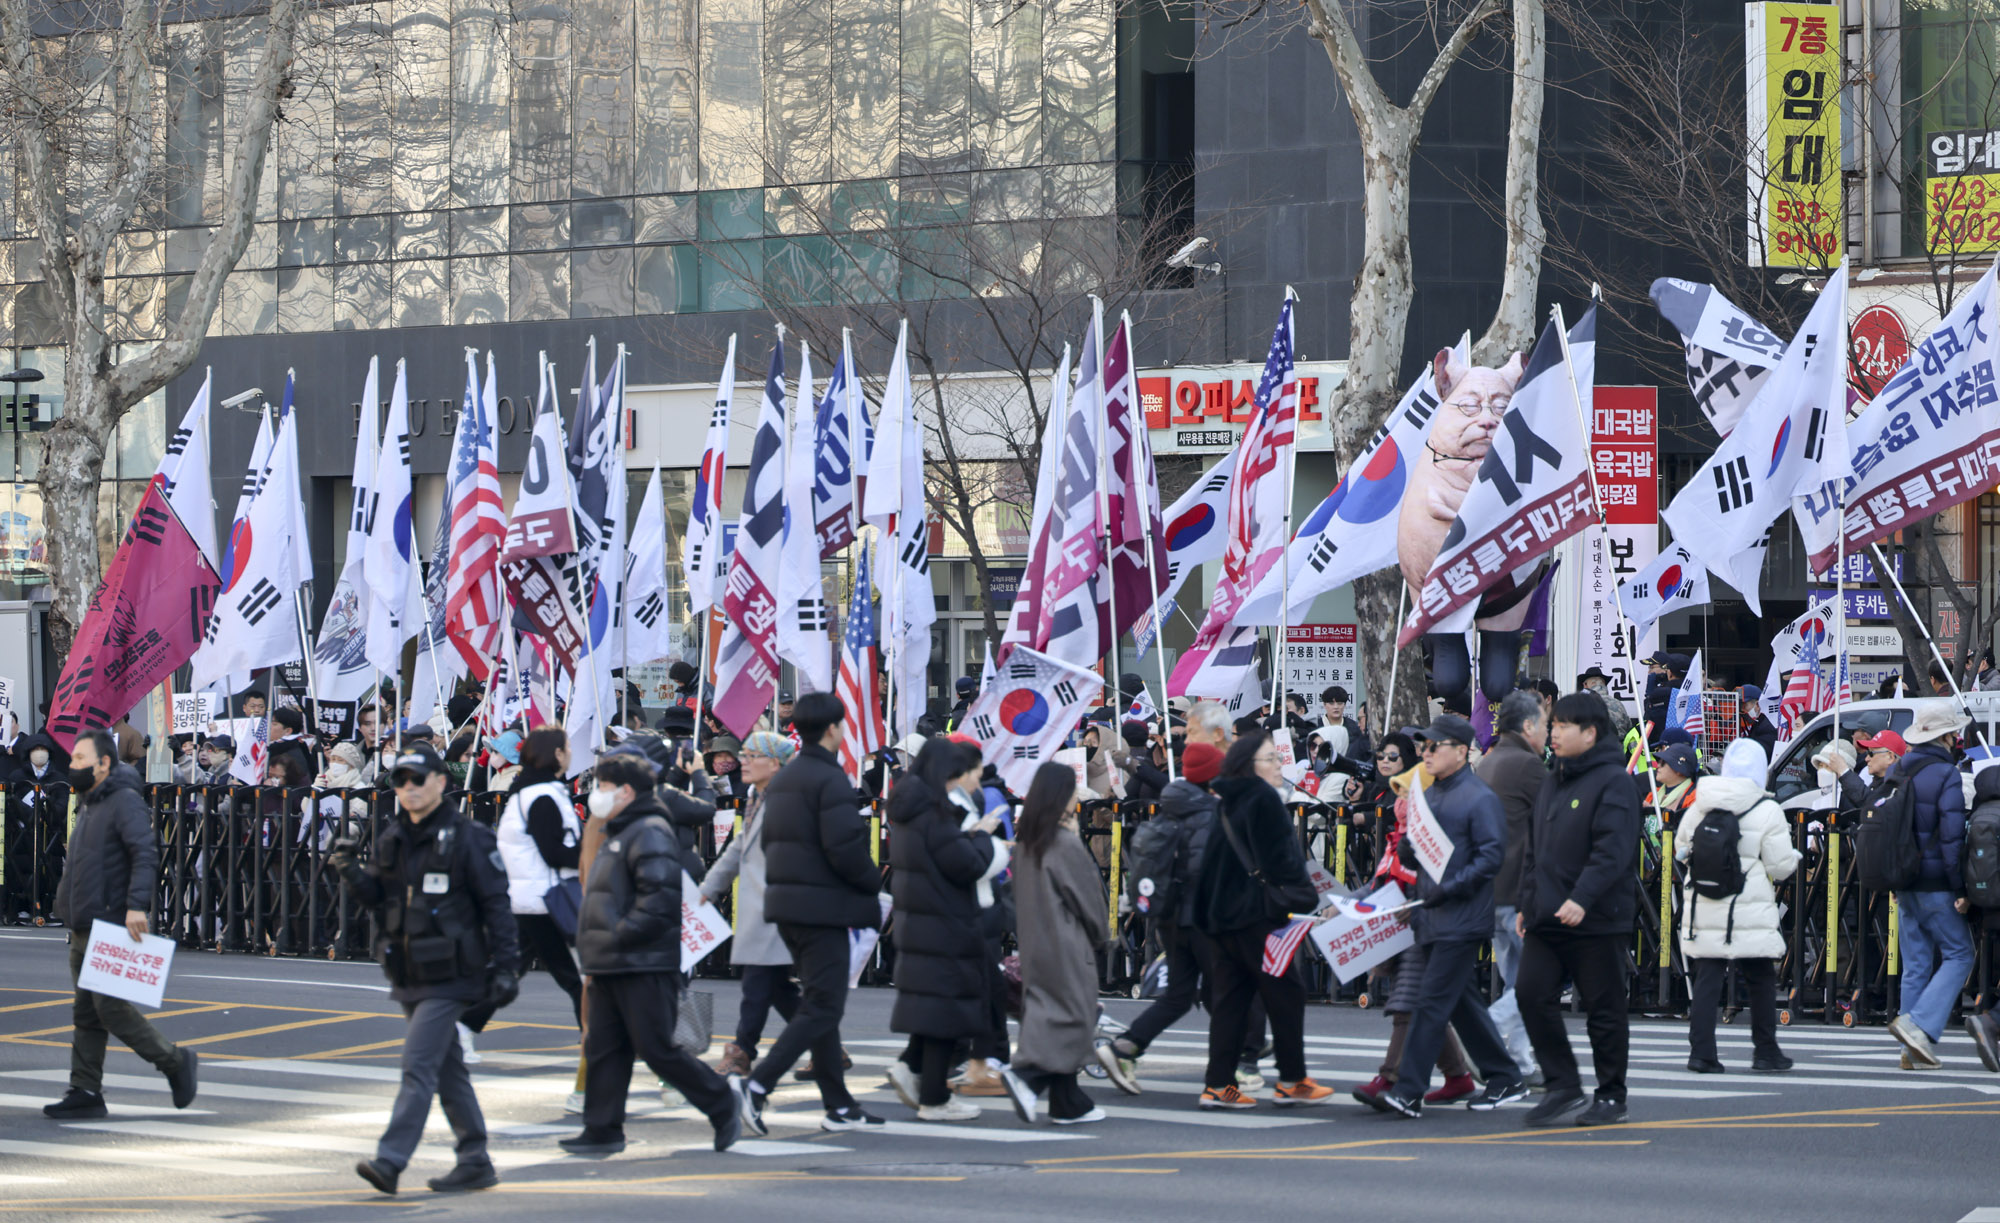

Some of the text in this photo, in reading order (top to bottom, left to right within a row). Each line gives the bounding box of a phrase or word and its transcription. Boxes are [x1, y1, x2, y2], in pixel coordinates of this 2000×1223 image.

[1779, 16, 1828, 54] 7층
[1781, 69, 1826, 185] 임대
[1931, 130, 2000, 173] 임대
[1933, 179, 1996, 212] 523-
[1143, 404, 1163, 413] EPOT
[1171, 377, 1322, 424] 오피스포
[1592, 408, 1654, 436] 대국밥
[1179, 431, 1204, 445] 사무용품
[1592, 449, 1654, 479] 육국밥
[1609, 537, 1641, 702] 보회관
[1279, 646, 1354, 659] 무용품 전산용품
[1850, 672, 1876, 685] 무법인
